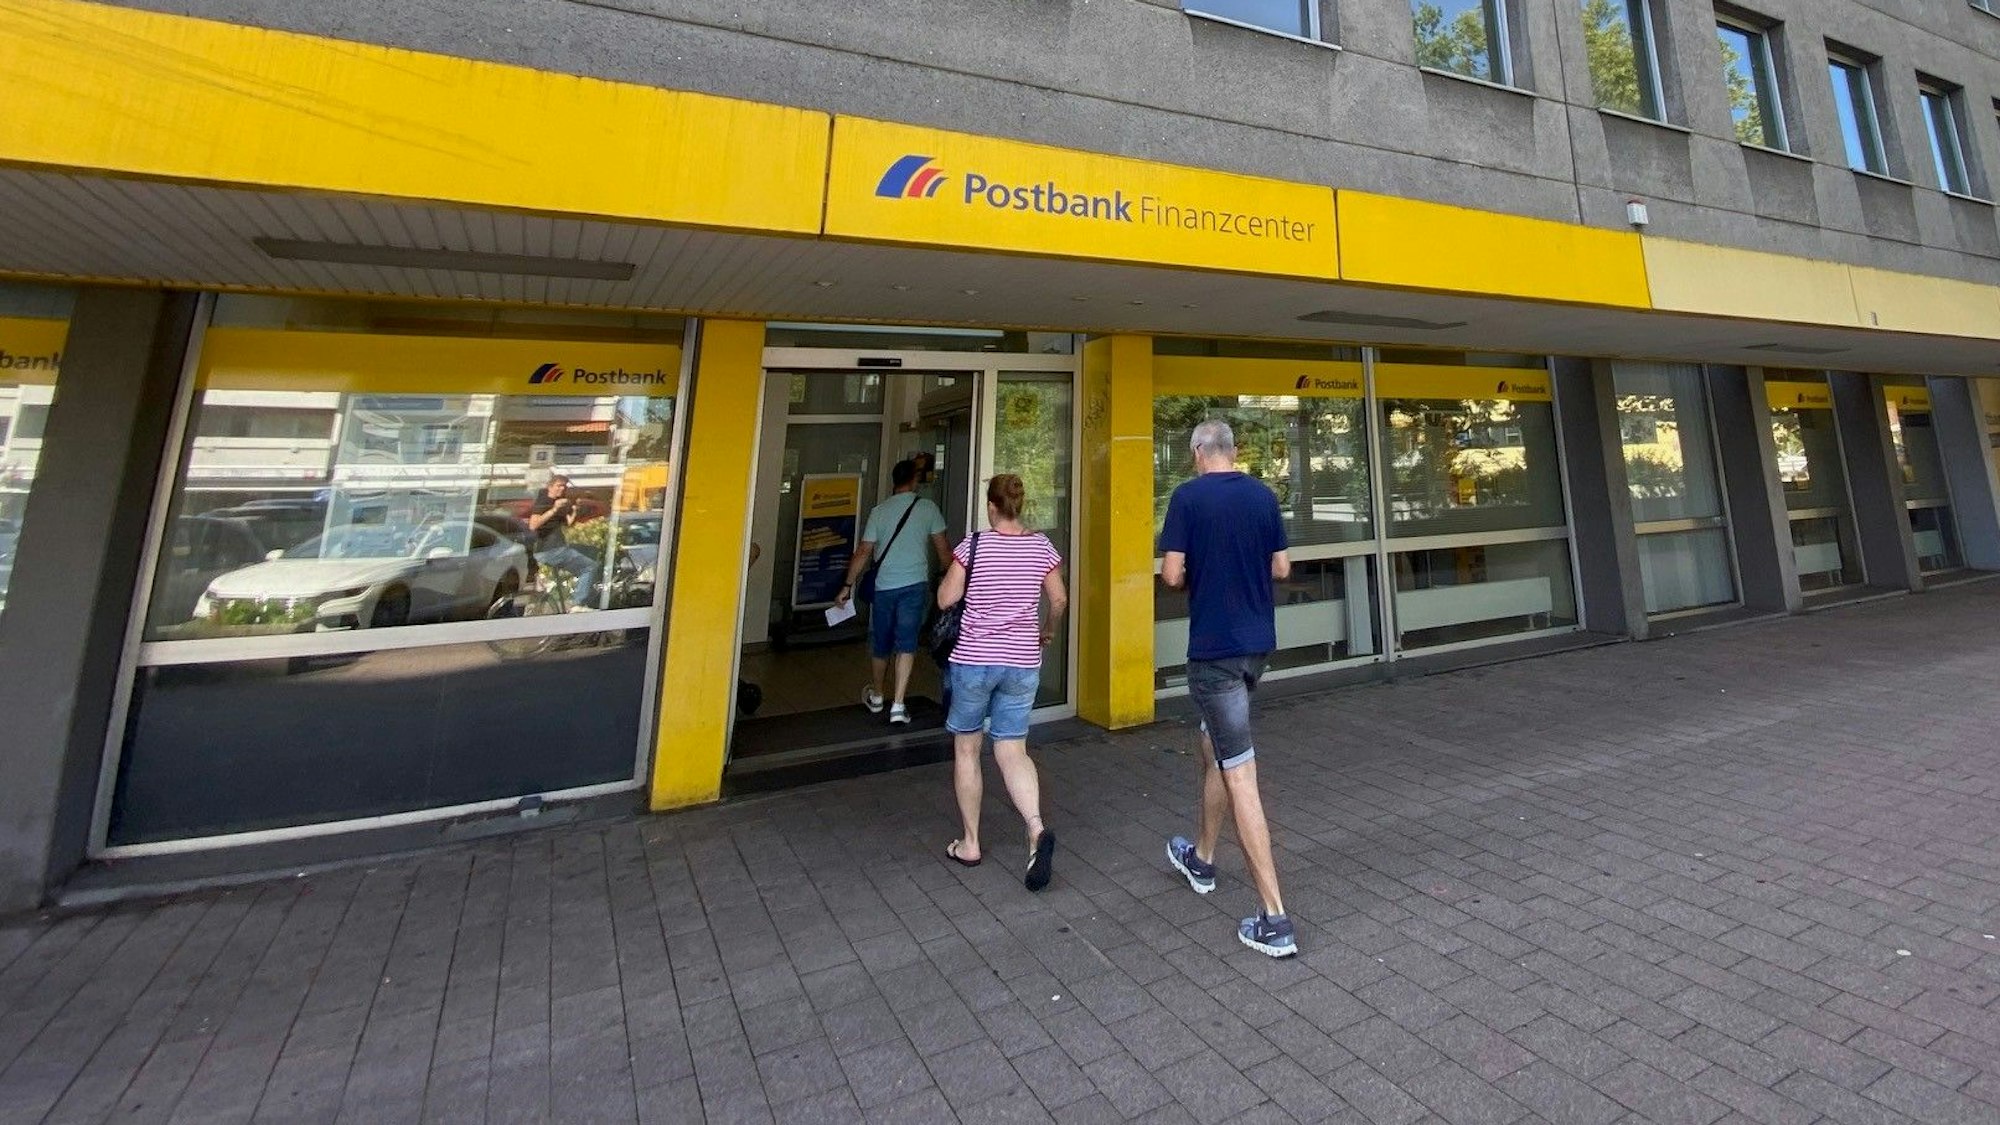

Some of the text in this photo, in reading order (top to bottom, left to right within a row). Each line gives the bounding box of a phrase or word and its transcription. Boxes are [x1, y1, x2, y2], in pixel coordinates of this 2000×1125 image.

[963, 173, 1315, 242] Postbank Finanzcenter
[573, 367, 667, 385] Postbank
[1315, 378, 1358, 389] Postbank
